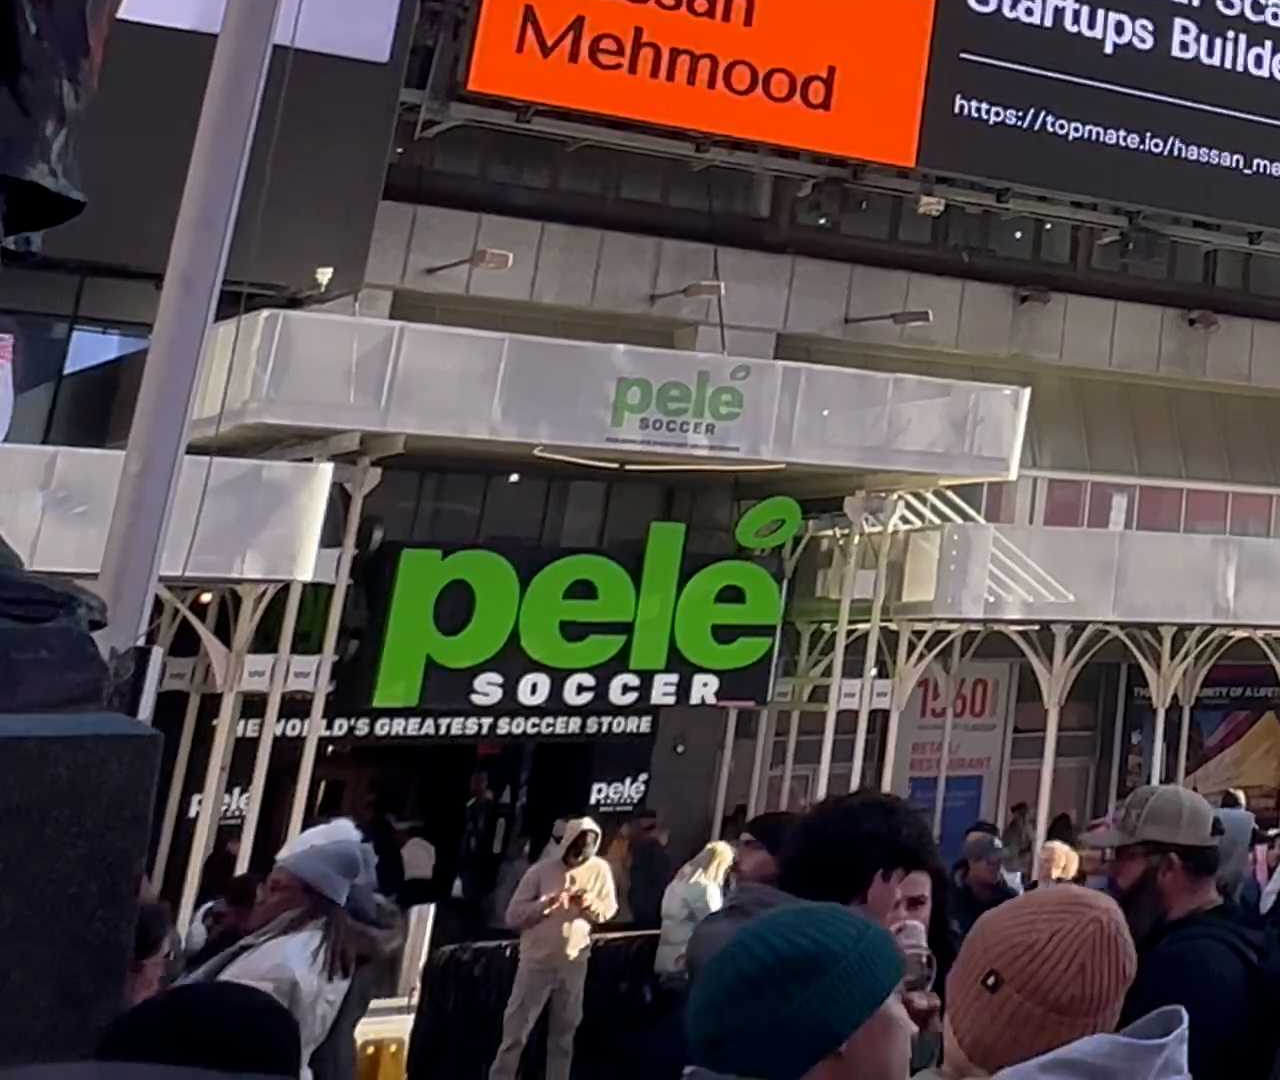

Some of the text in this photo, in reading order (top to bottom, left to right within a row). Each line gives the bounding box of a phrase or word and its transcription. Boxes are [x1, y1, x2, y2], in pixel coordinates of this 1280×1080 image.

[514, 3, 836, 114] Mehmood
[611, 364, 751, 428] pelé
[638, 416, 716, 436] SOCCER
[372, 495, 802, 708] pelé
[469, 672, 721, 707] SOCCER
[374, 717, 493, 736] GREATEST
[497, 716, 582, 735] SOCCER
[586, 716, 652, 734] STORE
[590, 773, 649, 805] pelé
